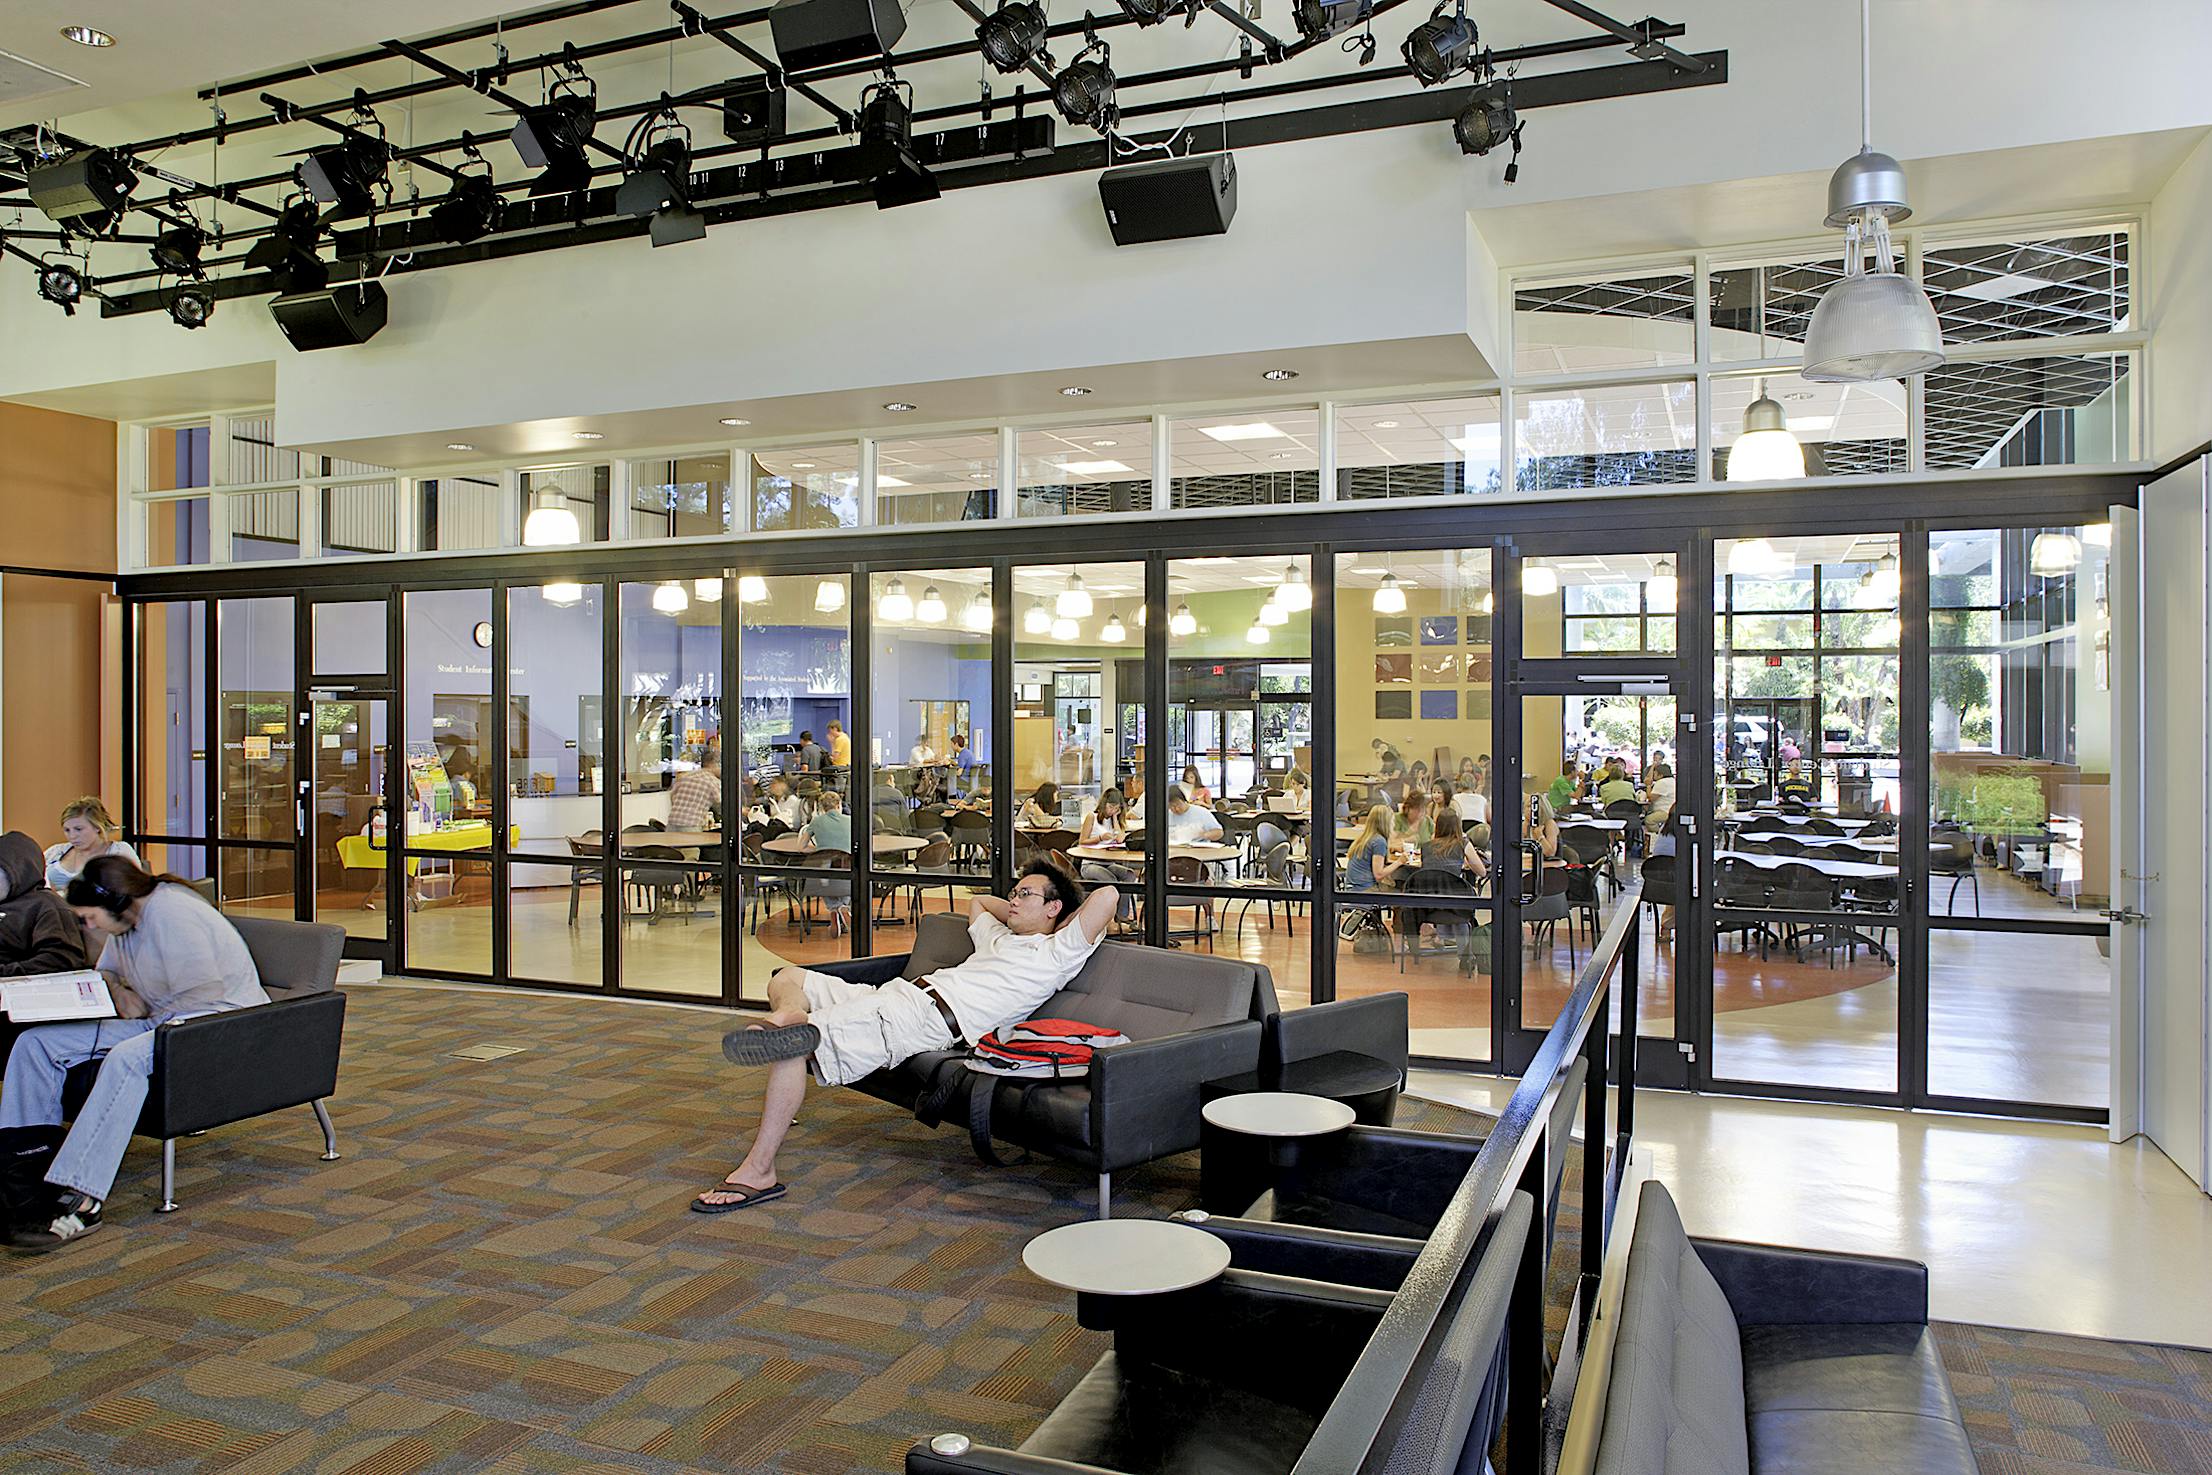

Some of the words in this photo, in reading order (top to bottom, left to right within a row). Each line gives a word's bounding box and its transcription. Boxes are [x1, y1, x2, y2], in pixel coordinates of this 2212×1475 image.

[689, 173, 697, 186] 10
[701, 172, 709, 184] 11
[738, 166, 747, 178] 12
[775, 159, 784, 172] 13
[814, 153, 823, 166] 14
[935, 132, 945, 146] 17
[978, 126, 988, 139] 18
[437, 663, 462, 673] Student
[1212, 665, 1225, 675] EXIT
